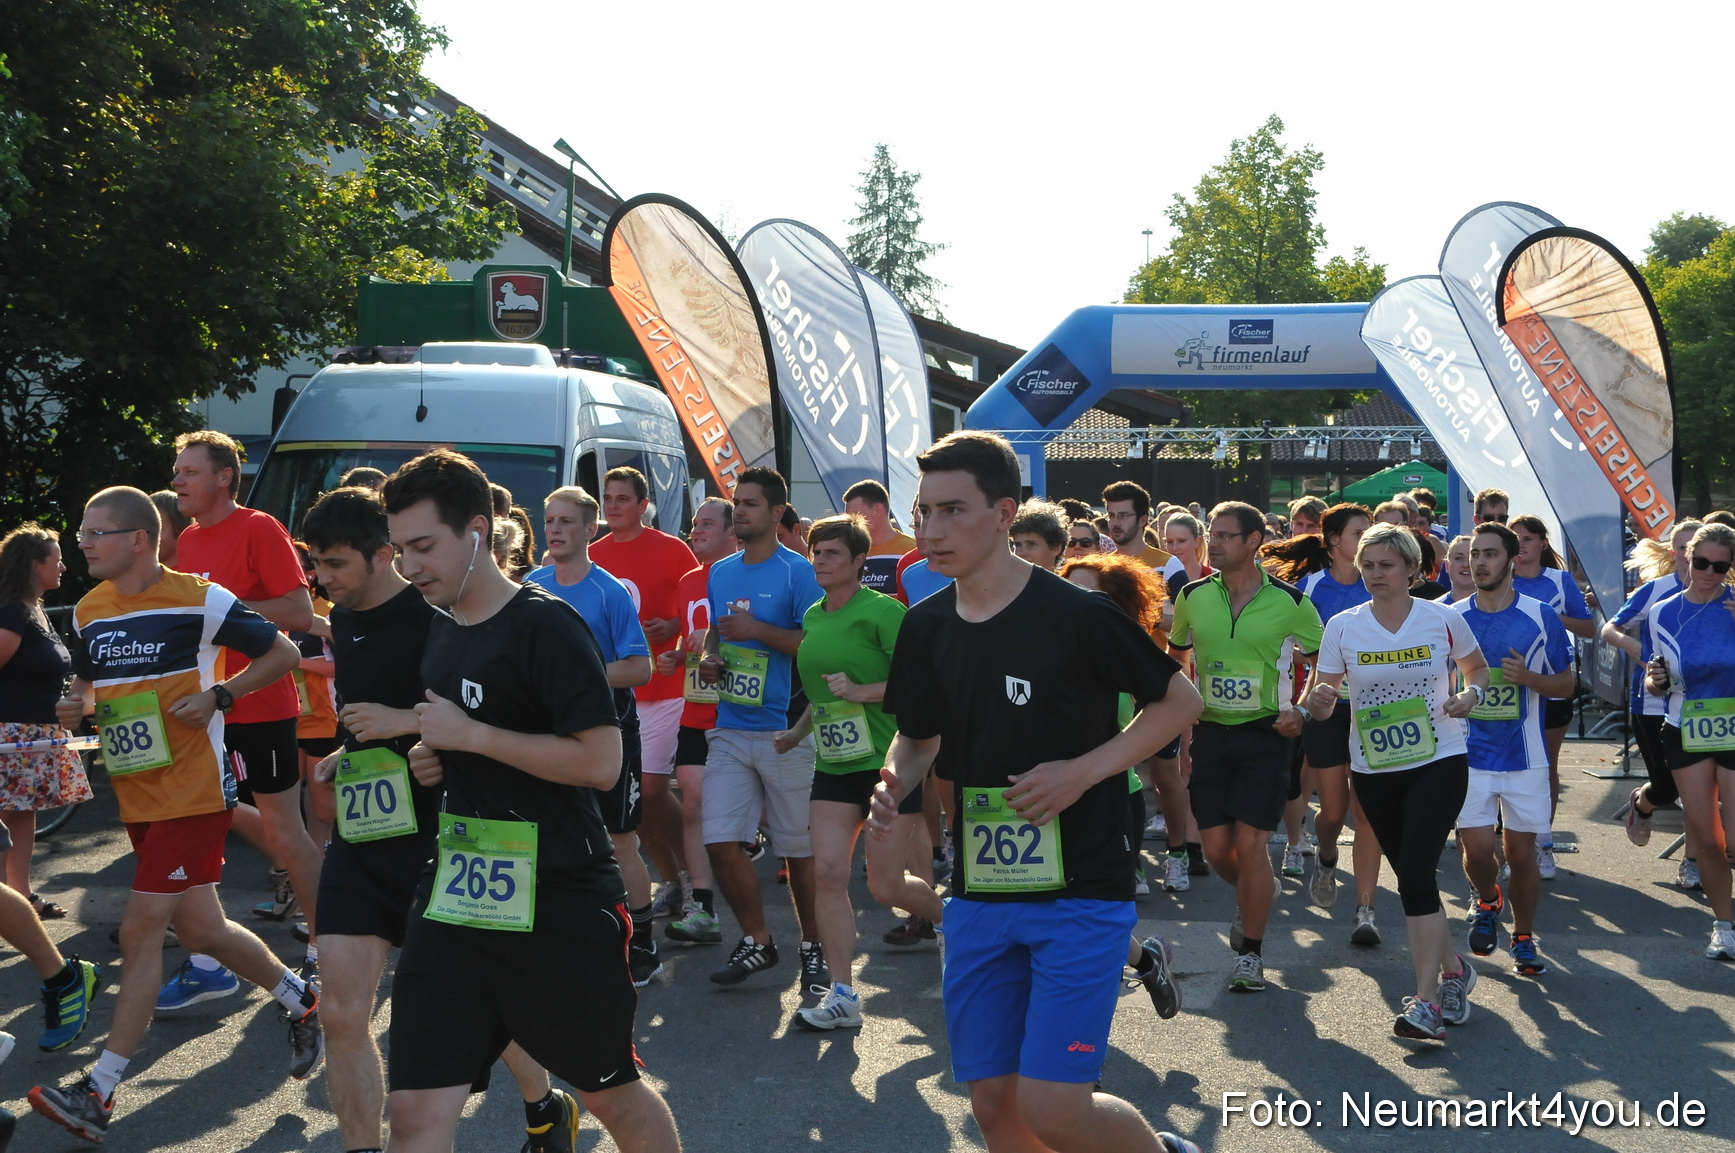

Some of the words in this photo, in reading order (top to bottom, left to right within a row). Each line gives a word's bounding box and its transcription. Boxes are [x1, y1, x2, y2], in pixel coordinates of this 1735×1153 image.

[505, 324, 531, 334] 1628
[1213, 345, 1311, 363] firmenlauf
[1027, 379, 1079, 389] Fischer
[98, 640, 166, 660] Fischer
[1360, 648, 1425, 663] ONLINE
[105, 656, 160, 667] AUTOMOBILE
[1398, 660, 1432, 669] Germany
[1211, 677, 1252, 700] 583
[105, 721, 153, 756] 388
[819, 720, 859, 747] 563
[1370, 721, 1421, 752] 909
[341, 779, 397, 820] 270
[394, 821, 408, 829] GmbH
[973, 824, 1044, 865] 262
[445, 853, 516, 902] 265
[445, 906, 458, 915] Jäger
[468, 910, 502, 920] Röckersbühl
[457, 899, 479, 909] Benjamin
